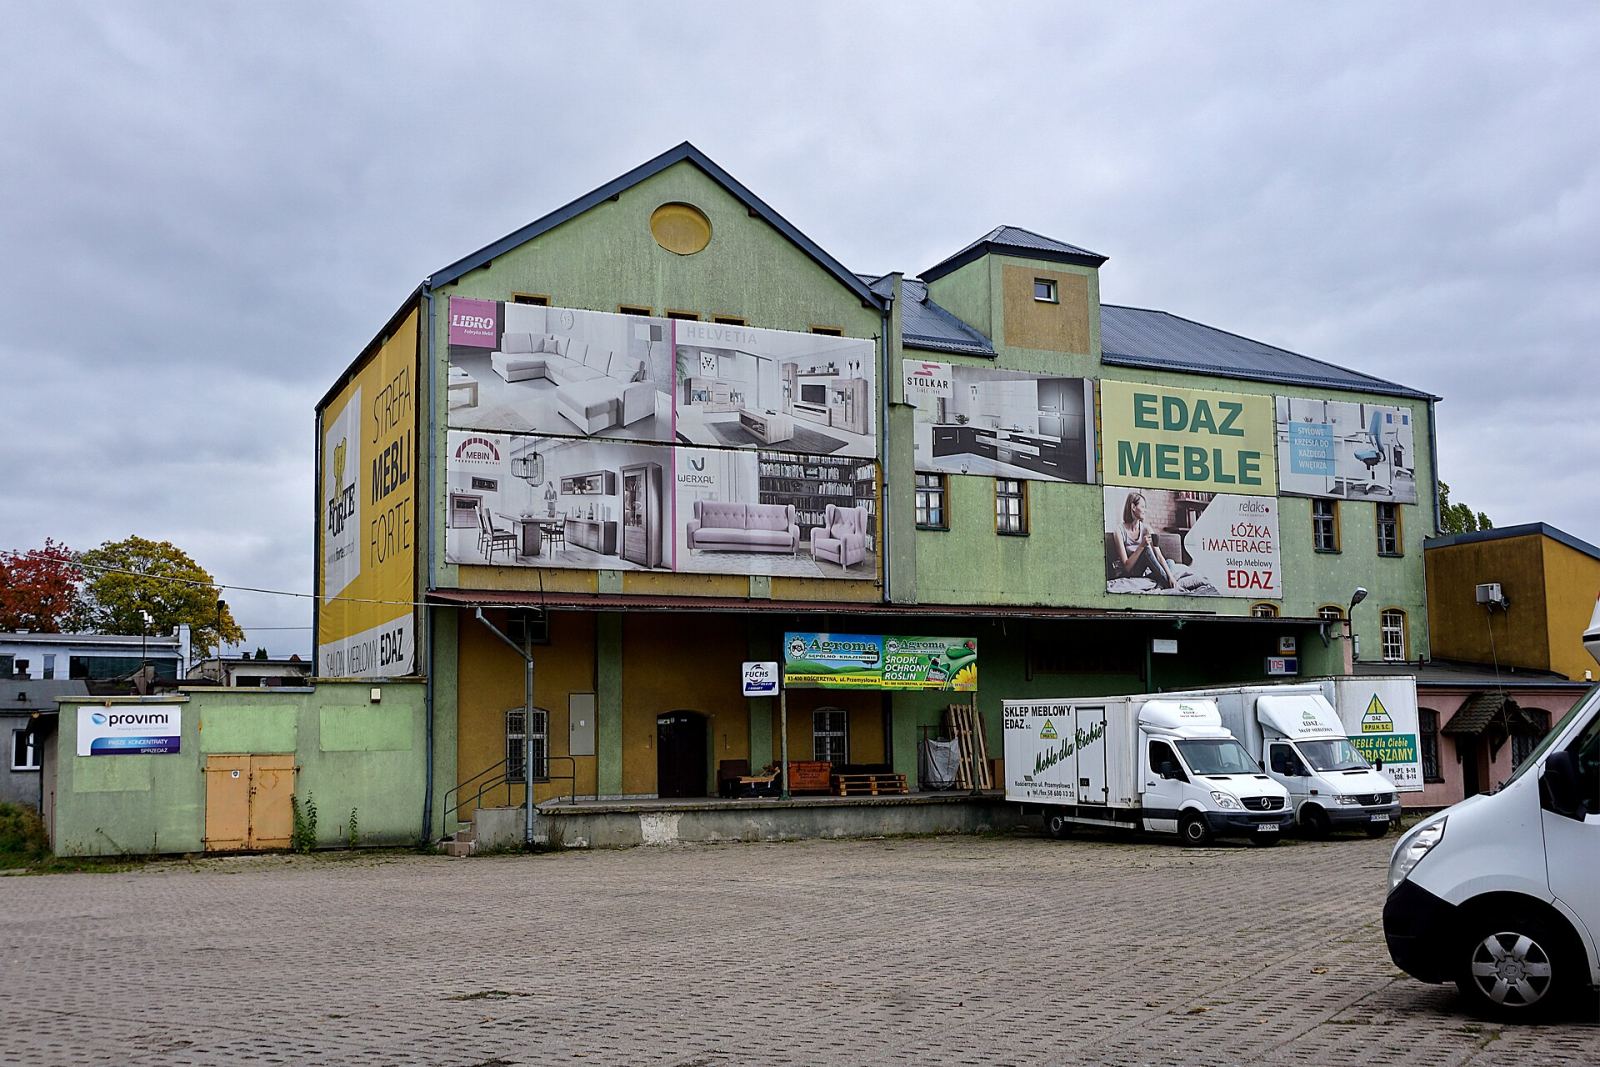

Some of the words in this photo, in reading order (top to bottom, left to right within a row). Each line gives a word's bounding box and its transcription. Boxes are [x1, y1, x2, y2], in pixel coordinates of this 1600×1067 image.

[452, 314, 494, 330] LIBRO
[687, 326, 757, 344] HELVETIA
[907, 376, 949, 389] STOLKAR
[373, 365, 411, 444] STREFA
[1133, 392, 1245, 437] EDAZ
[466, 451, 490, 460] MEBIN
[371, 429, 411, 506] MEBLI
[1117, 440, 1262, 486] MEBLE
[677, 474, 714, 484] WERXAL
[328, 482, 355, 538] FORTE
[370, 496, 410, 569] FORTE
[1231, 522, 1271, 538] ŁÓŻKA
[1202, 538, 1206, 551] i
[1208, 538, 1272, 553] MATERACE
[1226, 558, 1243, 568] Sklep
[1244, 559, 1272, 568] Meblowy
[1227, 570, 1273, 589] EDAZ
[809, 639, 877, 653] Agroma
[900, 640, 946, 649] Agroma
[326, 649, 345, 677] SALON
[380, 627, 404, 667] EDAZ
[885, 654, 918, 664] ŚRODKI
[745, 670, 769, 678] FUCHS
[885, 664, 928, 672] OCHRONY
[884, 671, 916, 680] ROŚLIN
[1005, 707, 1029, 717] SKLEP
[1031, 705, 1071, 717] MEBLOWY
[109, 714, 169, 727] provimi
[1005, 719, 1025, 729] EDAZ
[1033, 746, 1058, 776] Meble
[1059, 737, 1074, 761] dla
[1075, 721, 1103, 750] Ciebie
[1375, 737, 1386, 747] dla
[1387, 737, 1408, 747] Ciebie
